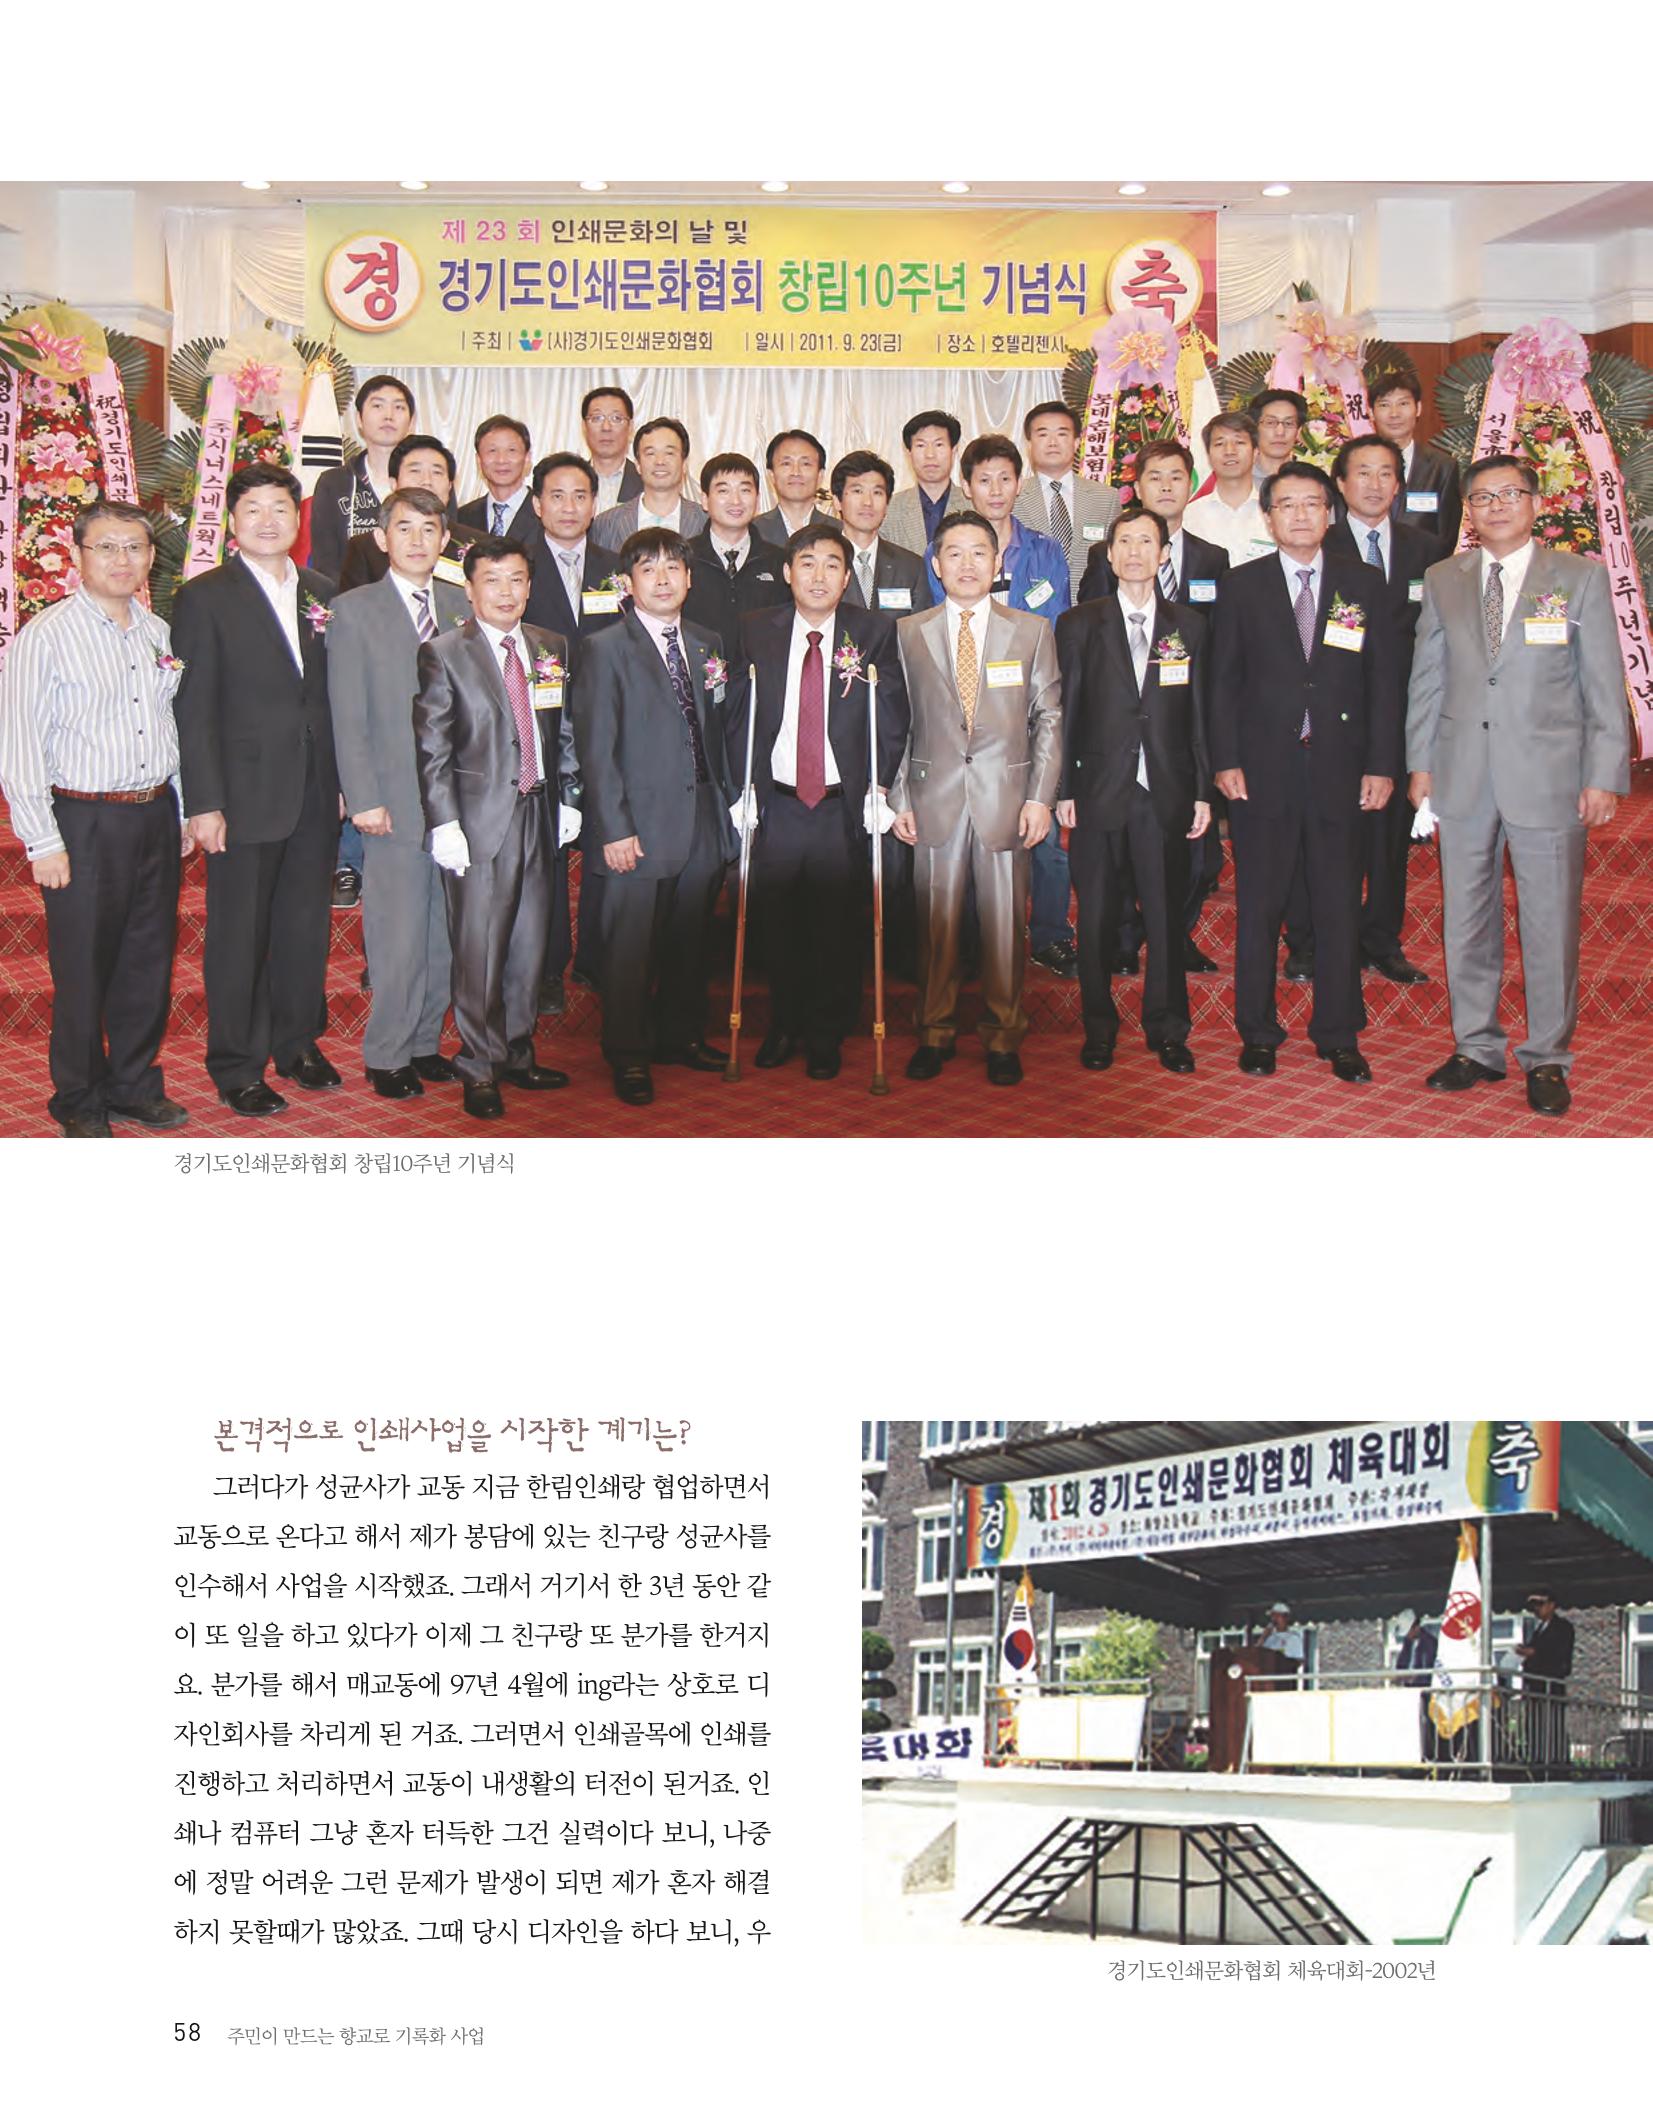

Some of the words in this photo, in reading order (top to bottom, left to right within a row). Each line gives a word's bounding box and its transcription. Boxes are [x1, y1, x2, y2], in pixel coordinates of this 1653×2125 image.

[441, 220, 465, 244] 제
[476, 221, 506, 242] 23
[517, 220, 541, 244] 회
[551, 220, 679, 244] 인쇄문화의
[690, 220, 714, 244] 날
[725, 220, 749, 244] 및
[343, 241, 400, 321] 경
[438, 257, 763, 313] 경기도인쇄문화협회
[778, 259, 967, 314] 창립10주년
[982, 261, 1086, 316] 기념식
[1120, 248, 1188, 322] 축
[472, 331, 501, 351] 주최
[755, 332, 785, 352] 일시
[947, 334, 976, 353] 장소
[1346, 394, 1369, 420] 祝
[1575, 410, 1602, 435] 祝
[174, 1152, 347, 1175] 경기도인쇄문화협회
[354, 1152, 451, 1175] 창립10주년
[458, 1152, 514, 1175] 기념식
[213, 1417, 344, 1454] 본격적으로
[354, 1416, 492, 1454] 인쇄사업을
[500, 1417, 590, 1454] 시작한
[597, 1416, 691, 1453] 계기는?
[1487, 1422, 1541, 1493] 축
[1028, 1479, 1081, 1523] 제1회
[1088, 1441, 1313, 1517] 경기도인쇄문화협회
[1326, 1421, 1450, 1484] 체육대회
[212, 1473, 309, 1501] 그러다가
[315, 1473, 412, 1501] 성균사가
[416, 1474, 466, 1501] 교동
[472, 1473, 520, 1501] 지금
[526, 1473, 646, 1501] 한림인쇄랑
[652, 1473, 769, 1501] 협업하면서
[173, 1524, 270, 1550] 교동으로
[275, 1522, 348, 1550] 온다고
[354, 1522, 400, 1550] 해서
[409, 1522, 458, 1550] 제가
[463, 1522, 534, 1550] 봉담에
[543, 1522, 591, 1550] 있는
[597, 1522, 670, 1550] 친구랑
[676, 1522, 772, 1550] 성균사를
[977, 1499, 1006, 1549] 경
[174, 1572, 267, 1600] 인수해서
[275, 1572, 348, 1600] 사업을
[354, 1572, 455, 1600] 시작했죠.
[460, 1572, 531, 1600] 그래서
[540, 1572, 609, 1600] 거기서
[617, 1572, 643, 1599] 한
[649, 1572, 685, 1598] 3년
[691, 1572, 741, 1600] 동안
[746, 1572, 772, 1599] 같
[174, 1621, 195, 1649] 이
[204, 1624, 230, 1645] 또
[237, 1621, 285, 1648] 일을
[290, 1621, 340, 1649] 하고
[347, 1621, 419, 1649] 있다가
[425, 1621, 471, 1649] 이제
[479, 1625, 505, 1644] 그
[511, 1621, 584, 1649] 친구랑
[589, 1624, 615, 1645] 또
[620, 1621, 693, 1649] 분가를
[699, 1621, 769, 1649] 한거지
[173, 1672, 203, 1696] 요.
[210, 1671, 283, 1699] 분가를
[290, 1671, 336, 1699] 해서
[346, 1671, 440, 1699] 매교동에
[450, 1671, 499, 1697] 97년
[507, 1671, 568, 1699] 4월에
[577, 1671, 660, 1702] ing라는
[667, 1671, 740, 1698] 상호로
[747, 1671, 769, 1698] 디
[173, 1720, 294, 1748] 자인회사를
[299, 1720, 370, 1748] 차리게
[378, 1720, 402, 1747] 된
[410, 1720, 463, 1748] 거죠.
[469, 1720, 564, 1748] 그러면서
[574, 1720, 691, 1748] 인쇄골목에
[700, 1720, 772, 1748] 인쇄를
[174, 1770, 270, 1797] 진행하고
[276, 1769, 393, 1797] 처리하면서
[402, 1770, 472, 1797] 교동이
[481, 1770, 575, 1797] 내생활의
[584, 1770, 653, 1797] 터전이
[663, 1770, 740, 1797] 된거죠.
[748, 1770, 770, 1796] 인
[173, 1819, 223, 1847] 쇄나
[230, 1819, 299, 1847] 컴퓨터
[309, 1819, 359, 1846] 그냥
[365, 1819, 415, 1847] 혼자
[422, 1819, 495, 1847] 터득한
[501, 1819, 549, 1846] 그건
[559, 1819, 655, 1847] 실력이다
[661, 1819, 715, 1849] 보니,
[722, 1819, 772, 1847] 나중
[173, 1868, 196, 1896] 에
[206, 1868, 255, 1896] 정말
[262, 1868, 334, 1896] 어려운
[340, 1868, 388, 1895] 그런
[396, 1868, 469, 1896] 문제가
[476, 1868, 546, 1896] 발생이
[555, 1868, 603, 1896] 되면
[611, 1868, 661, 1896] 제가
[667, 1868, 716, 1896] 혼자
[723, 1868, 770, 1896] 해결
[173, 1918, 219, 1946] 하지
[228, 1918, 326, 1945] 못할때가
[331, 1918, 409, 1945] 많았죠.
[416, 1918, 463, 1945] 그때
[472, 1918, 518, 1945] 당시
[527, 1918, 624, 1946] 디자인을
[630, 1918, 680, 1946] 하다
[685, 1918, 740, 1948] 보니,
[746, 1918, 772, 1946] 우
[1107, 1959, 1281, 1982] 경기도인쇄문화협회
[1287, 1959, 1436, 1982] 체육대회-2002년
[174, 2022, 201, 2042] 58
[226, 2026, 277, 2046] 주민이
[283, 2026, 335, 2046] 만드는
[338, 2026, 391, 2046] 향교로
[395, 2026, 447, 2046] 기록화
[450, 2026, 484, 2046] 사업
